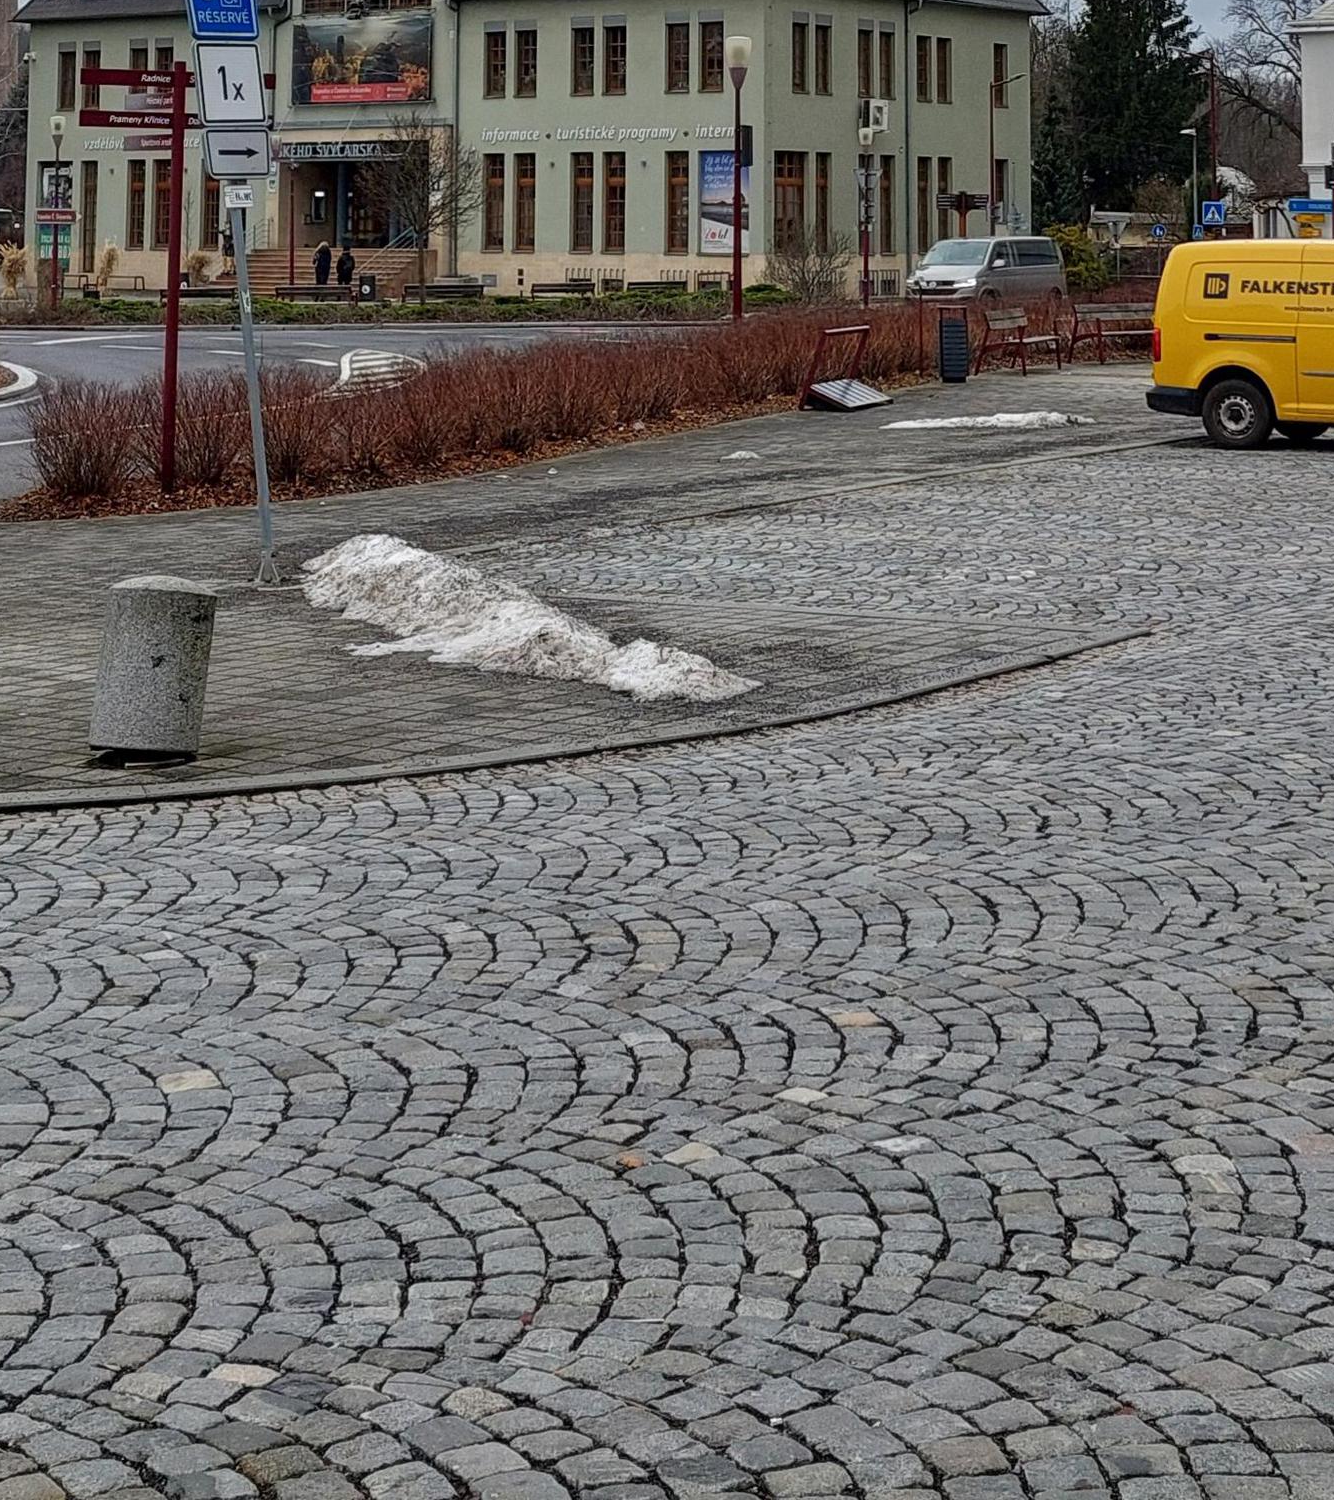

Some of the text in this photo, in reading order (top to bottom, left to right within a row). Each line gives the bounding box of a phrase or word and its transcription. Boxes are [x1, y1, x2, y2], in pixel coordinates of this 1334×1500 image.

[197, 8, 251, 25] RÉSERVÉ
[141, 73, 172, 84] Radnice
[109, 114, 171, 126] Prameny Křinice
[481, 124, 734, 145] informace turistické programy intern
